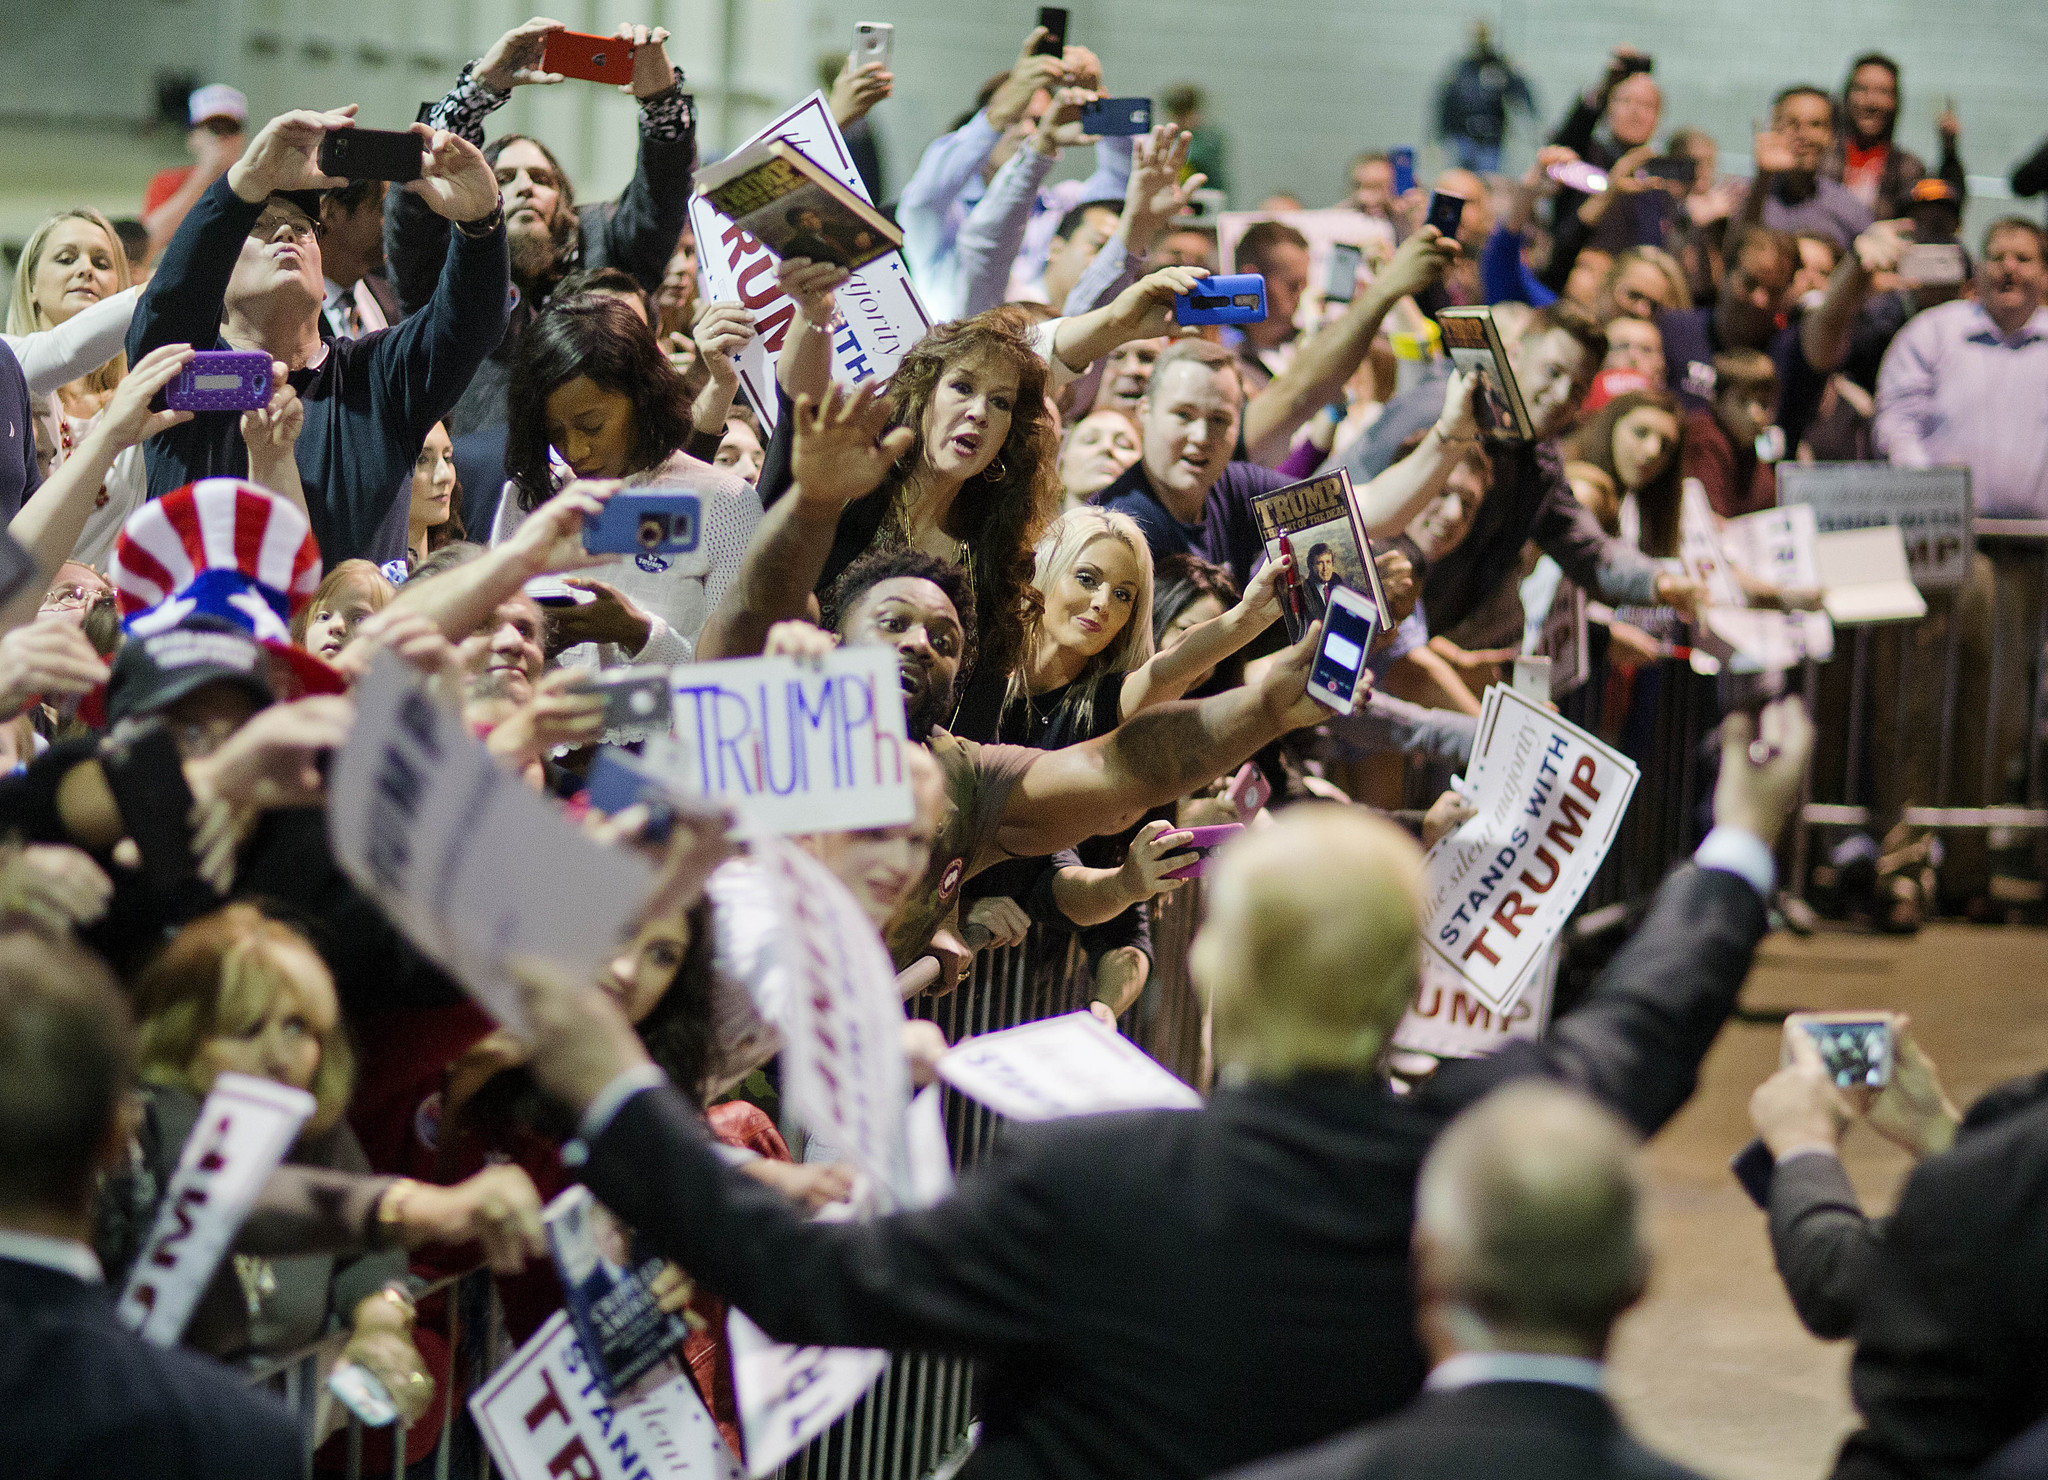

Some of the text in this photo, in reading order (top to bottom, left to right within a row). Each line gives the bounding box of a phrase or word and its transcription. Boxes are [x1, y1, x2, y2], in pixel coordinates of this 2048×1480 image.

[833, 311, 875, 385] ITH
[841, 273, 904, 355] ajority
[1254, 477, 1341, 529] TRUMP
[1439, 825, 1530, 946] STANDS
[1524, 733, 1569, 818] WITH
[1450, 823, 1494, 888] silent
[1494, 714, 1541, 825] majority
[1462, 754, 1602, 967] TRUMP
[1415, 988, 1532, 1032] UMP
